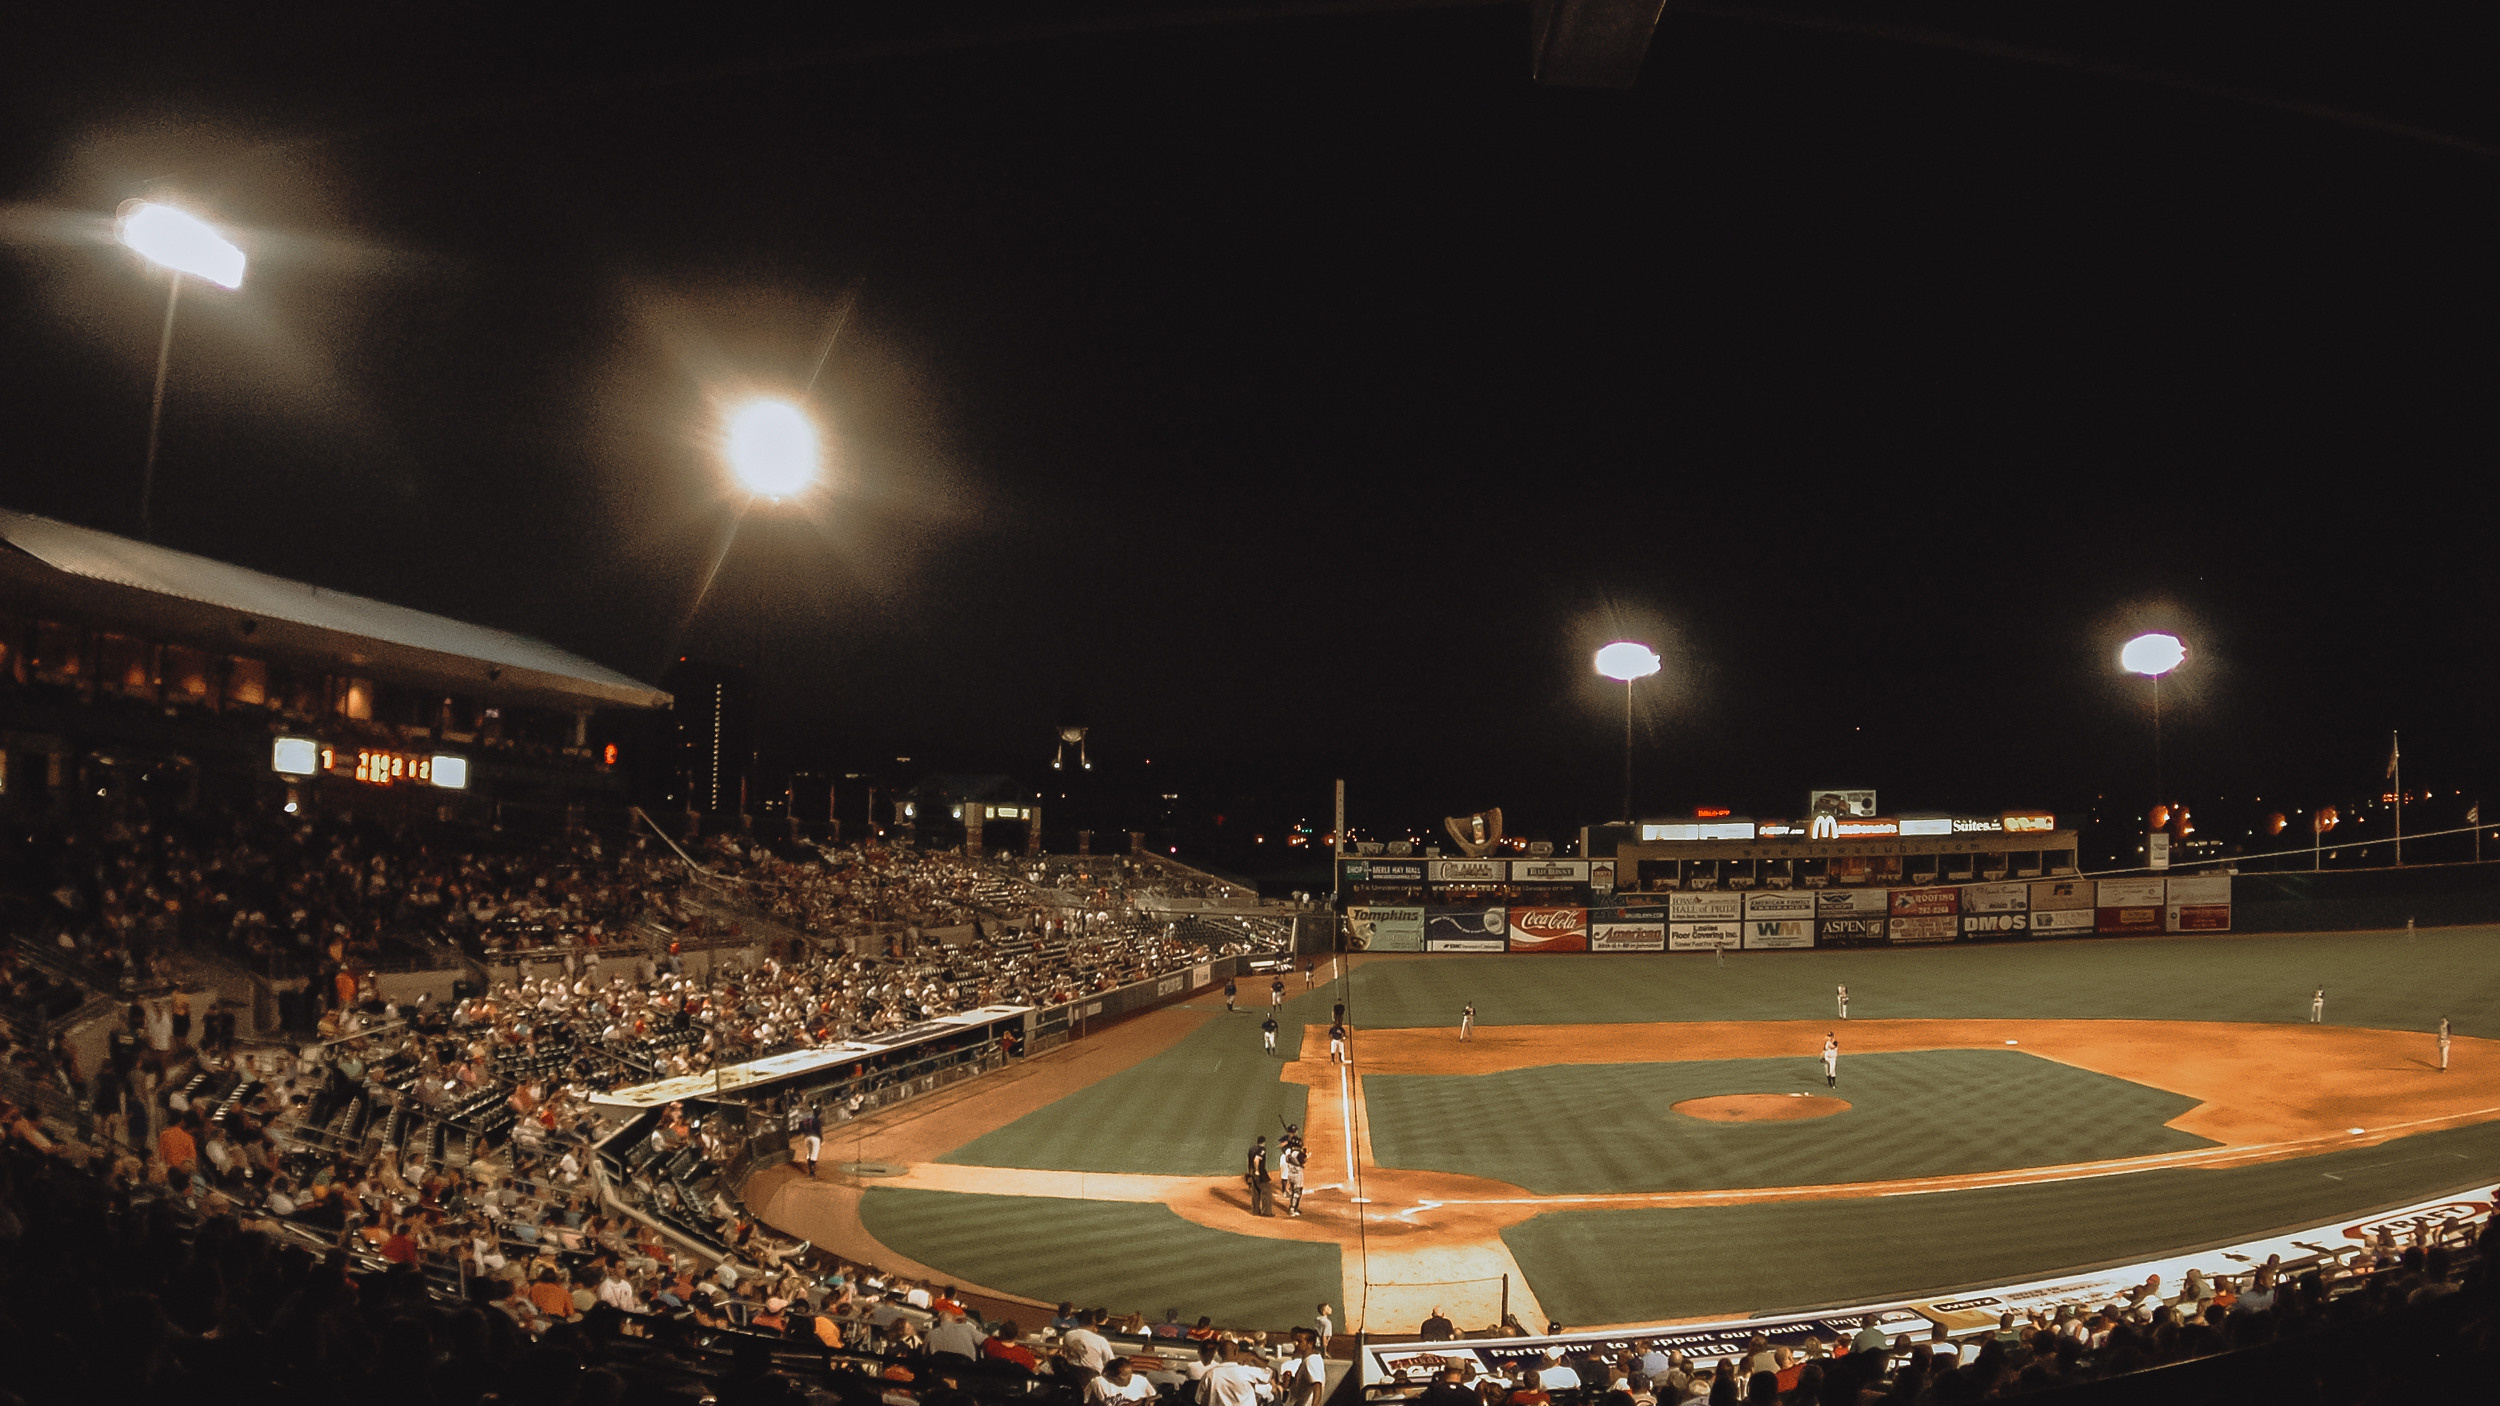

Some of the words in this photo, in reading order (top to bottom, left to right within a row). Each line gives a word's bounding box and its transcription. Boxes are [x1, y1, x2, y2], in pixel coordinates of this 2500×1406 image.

[1353, 909, 1419, 922] Tompkins
[1822, 920, 1866, 933] ASPEN
[1606, 1341, 1629, 1351] to
[1651, 1333, 1716, 1347] upport
[1720, 1330, 1752, 1340] our
[1758, 1323, 1814, 1338] youth
